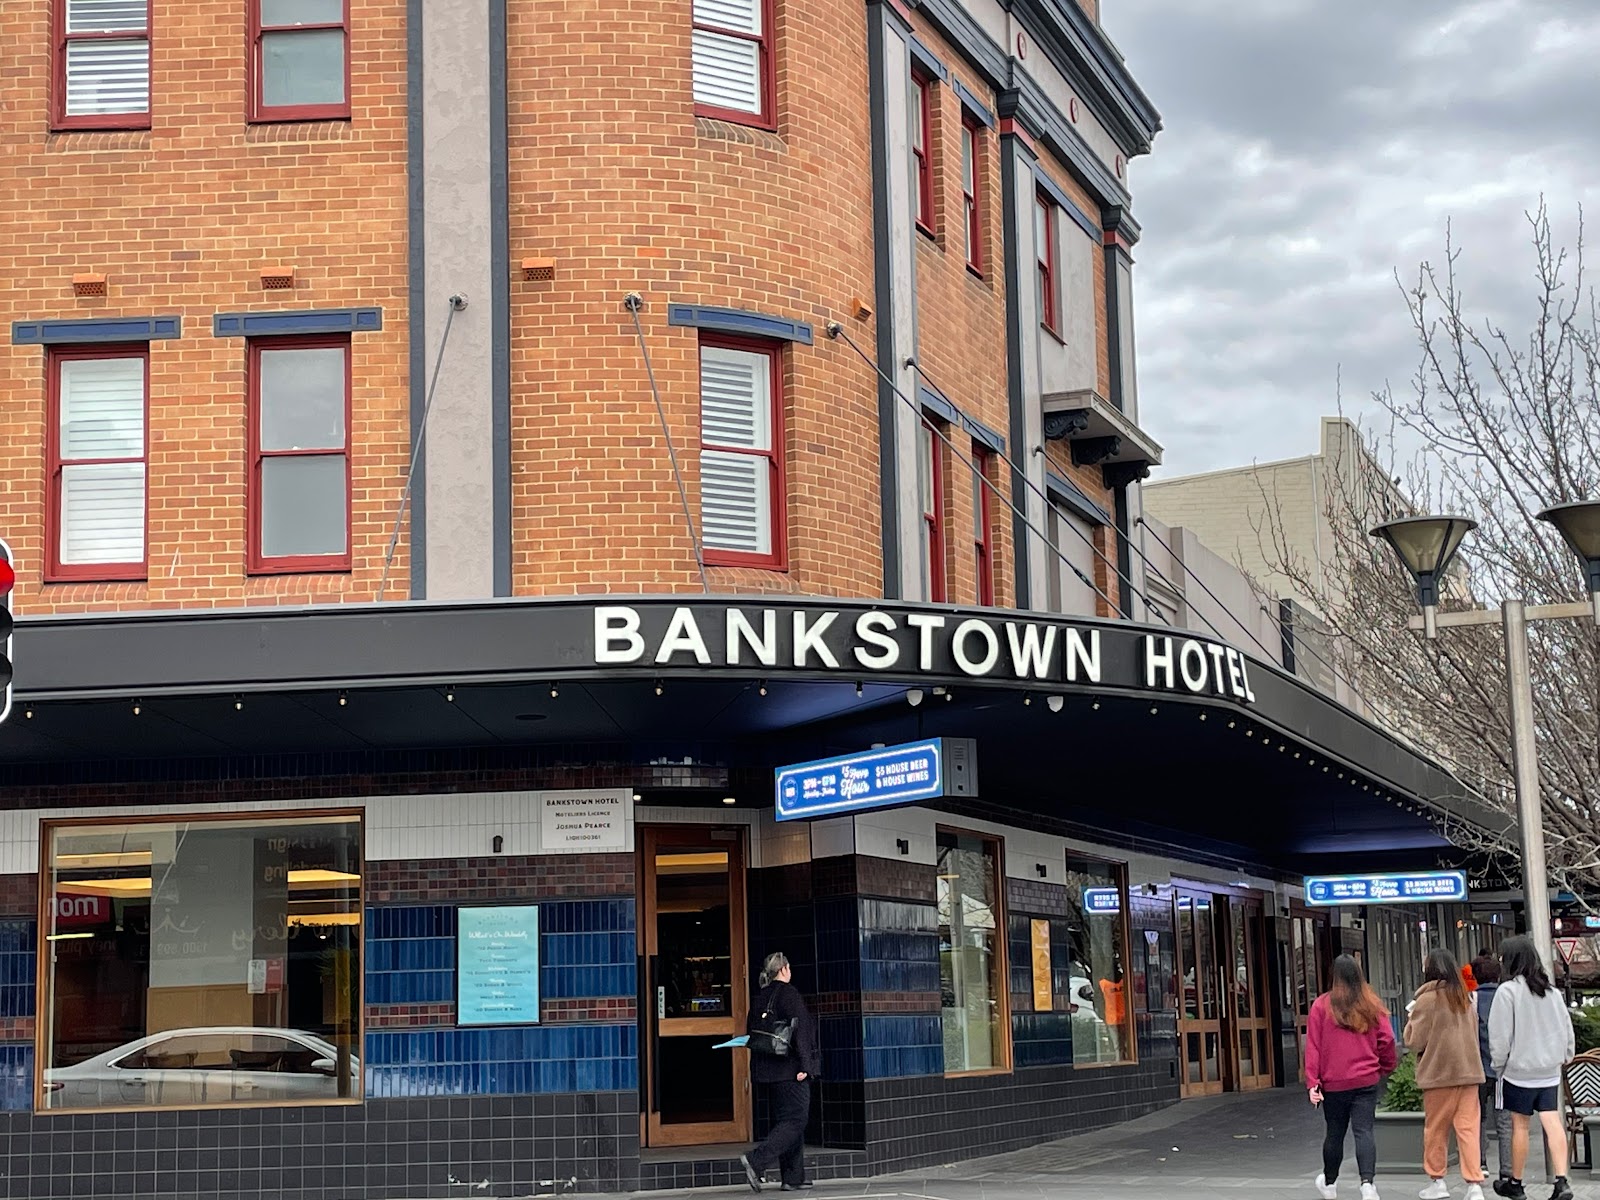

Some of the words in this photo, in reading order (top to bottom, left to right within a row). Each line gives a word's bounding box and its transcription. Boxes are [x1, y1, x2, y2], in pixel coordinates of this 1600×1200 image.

[594, 606, 1101, 682] BANKSTOWN
[1145, 634, 1256, 703] HOTEL
[886, 761, 909, 775] HOUSE
[910, 758, 928, 770] BEER
[882, 774, 906, 787] HOUSE
[906, 770, 929, 783] WINES
